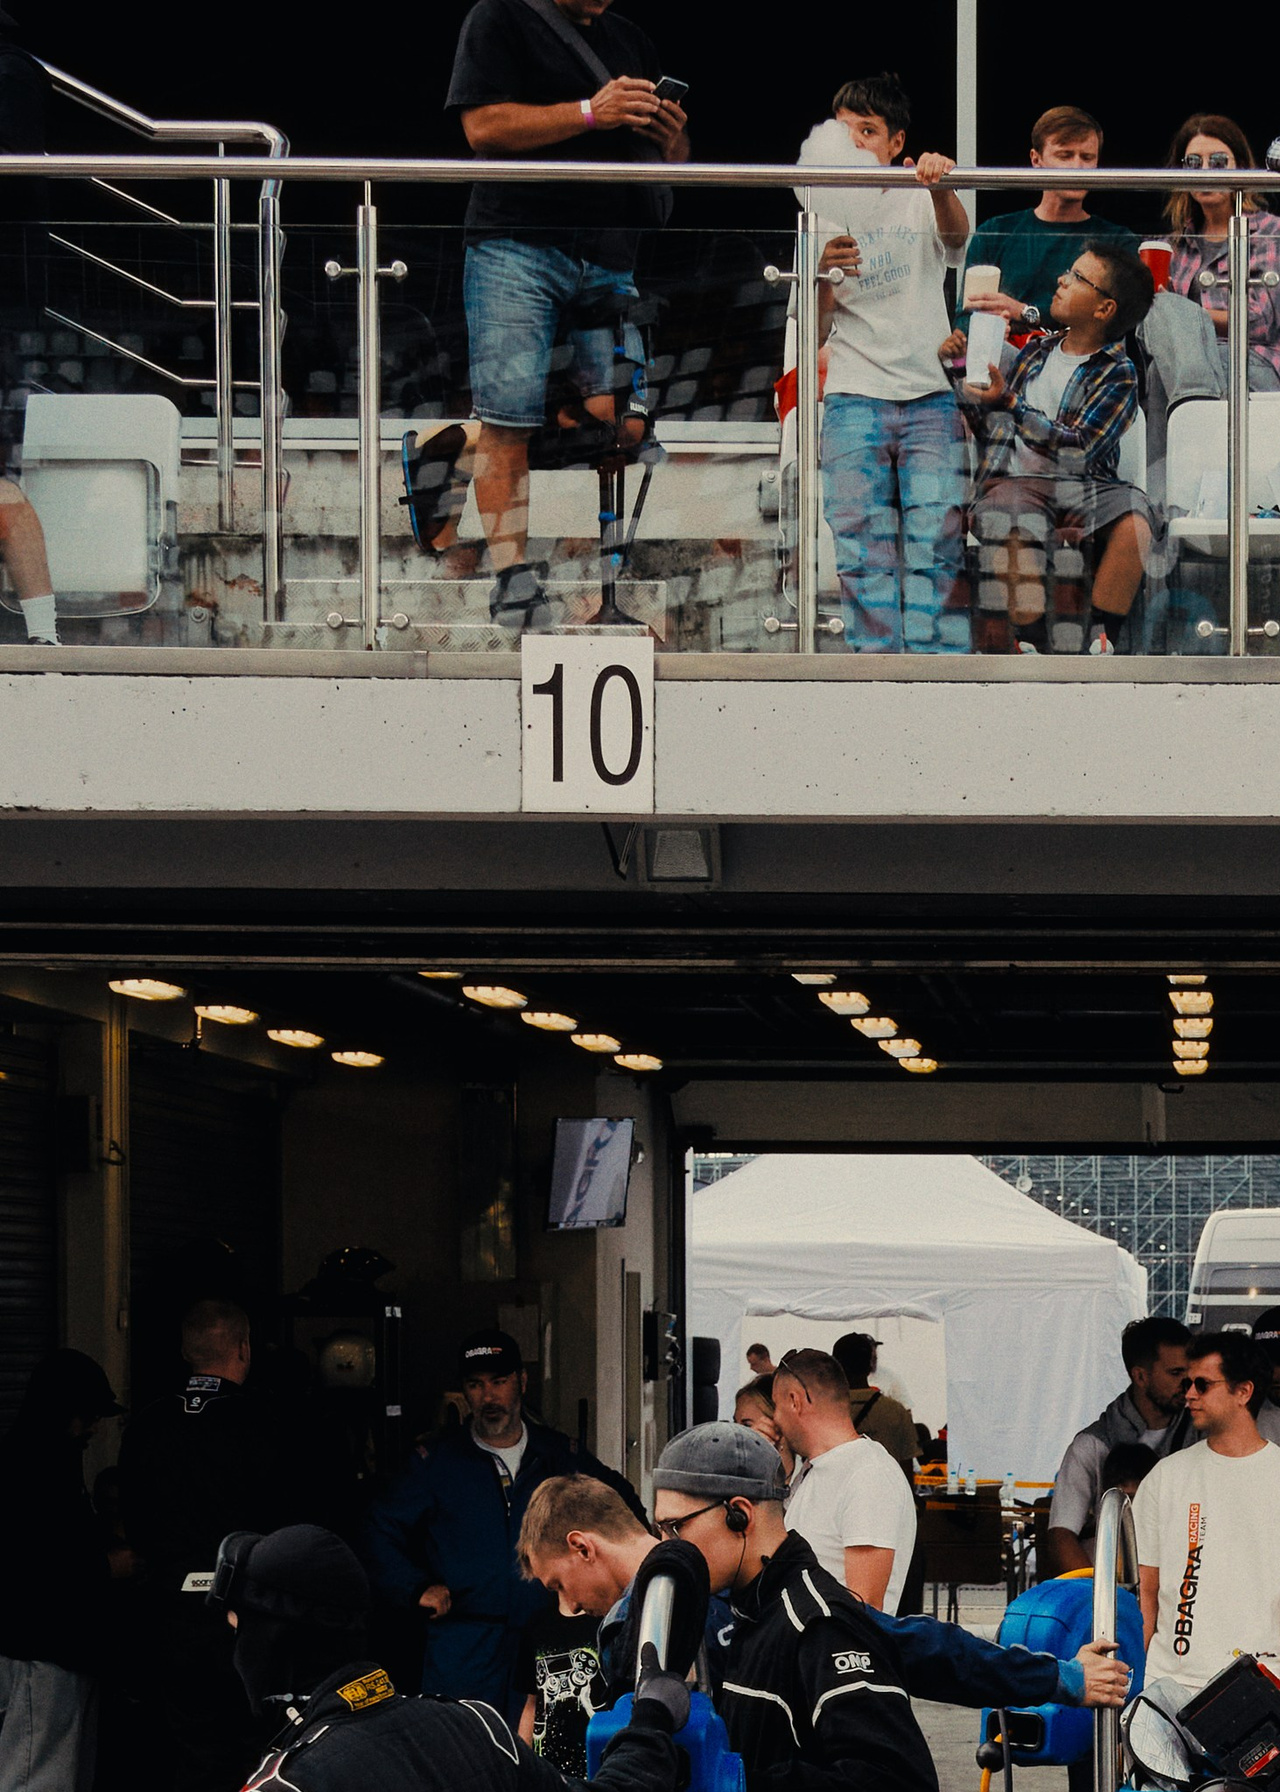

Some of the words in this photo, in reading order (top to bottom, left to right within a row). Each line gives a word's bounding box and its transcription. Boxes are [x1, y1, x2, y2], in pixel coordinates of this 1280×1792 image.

[532, 663, 644, 787] 10
[1173, 1544, 1204, 1656] OBAGRA
[1189, 1503, 1200, 1544] RACING
[833, 1653, 872, 1672] OMP
